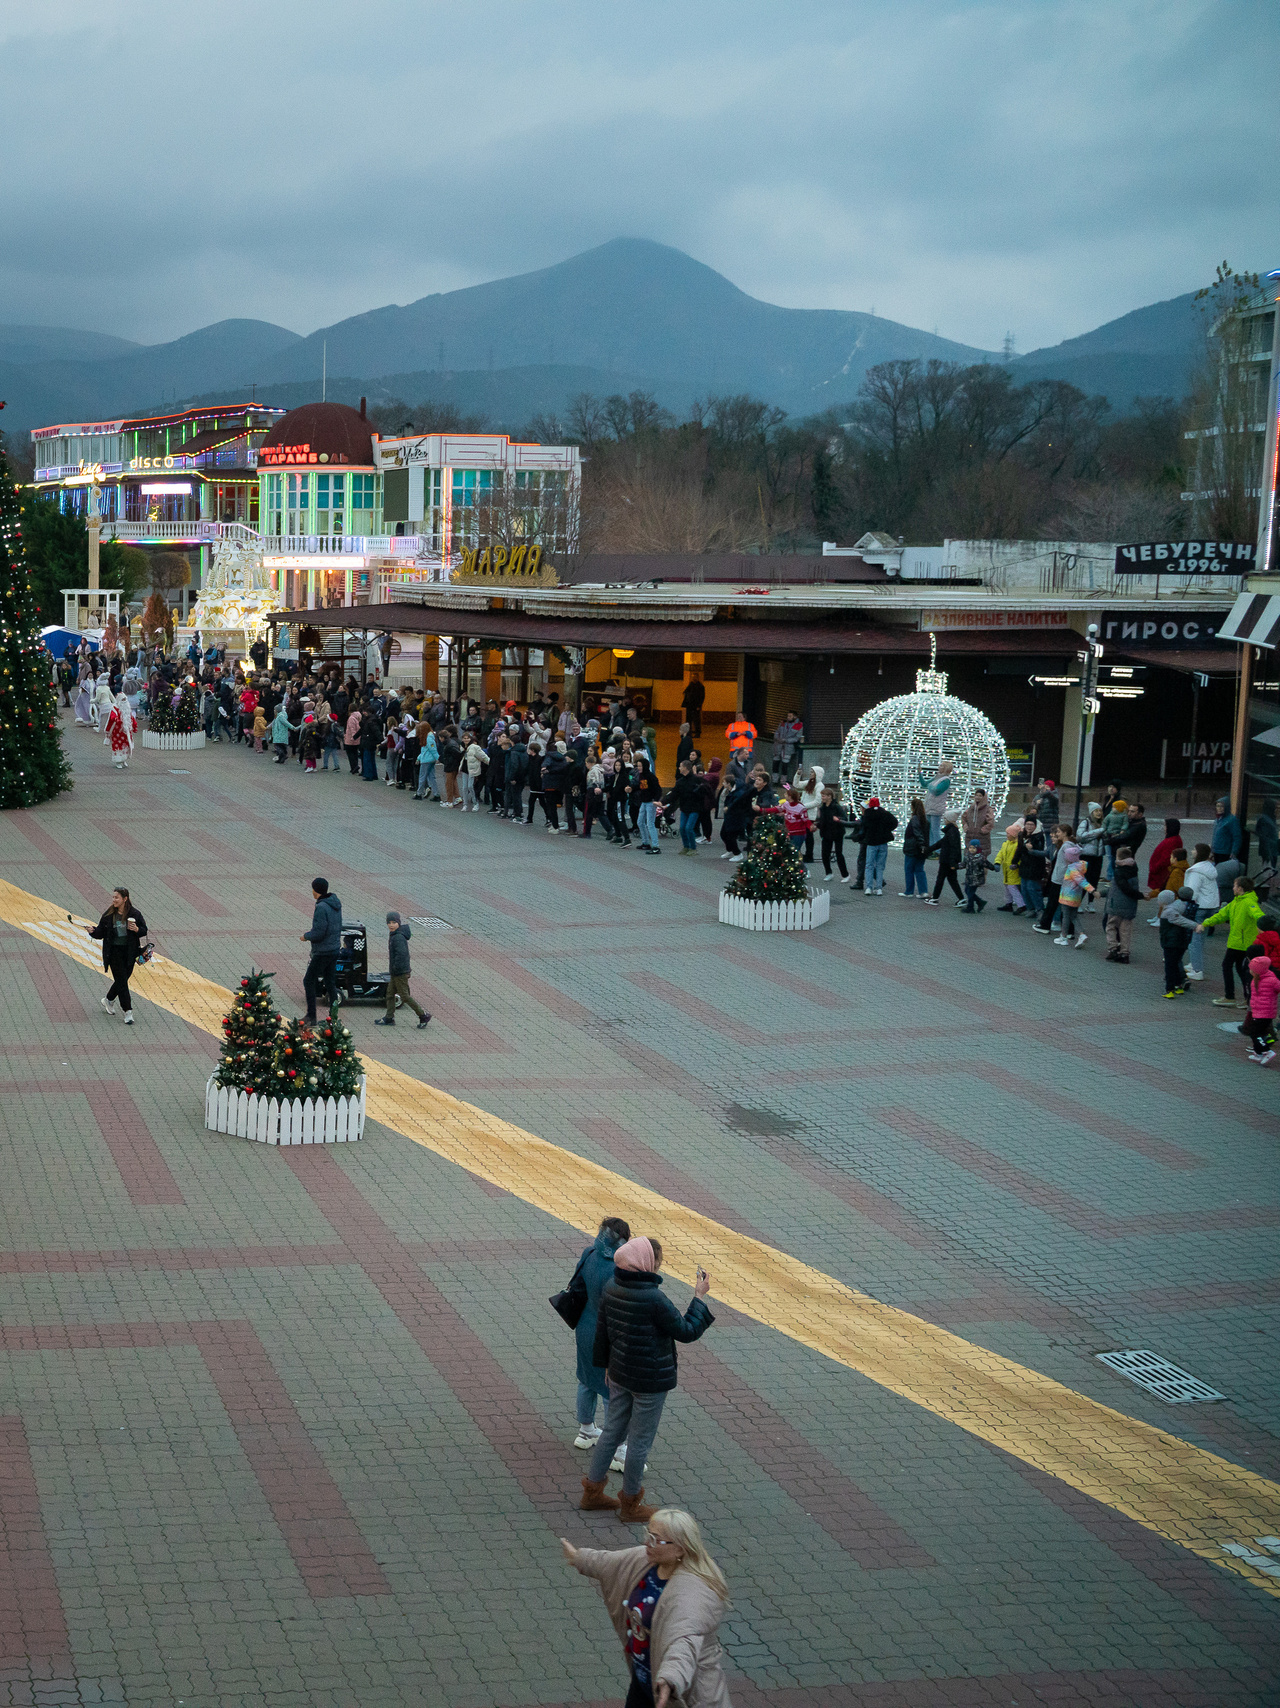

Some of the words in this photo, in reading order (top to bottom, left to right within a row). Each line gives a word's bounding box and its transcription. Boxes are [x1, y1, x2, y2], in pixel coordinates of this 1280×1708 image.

[285, 444, 310, 454] КЛУБ
[460, 545, 542, 576] МАРИЯ
[1122, 542, 1256, 562] ЧЕБУРЕЧН
[924, 613, 1003, 627] РАЗЛИВНЫЕ
[1007, 611, 1068, 625] НАПИТКИ
[1106, 622, 1200, 639] ГИРОС
